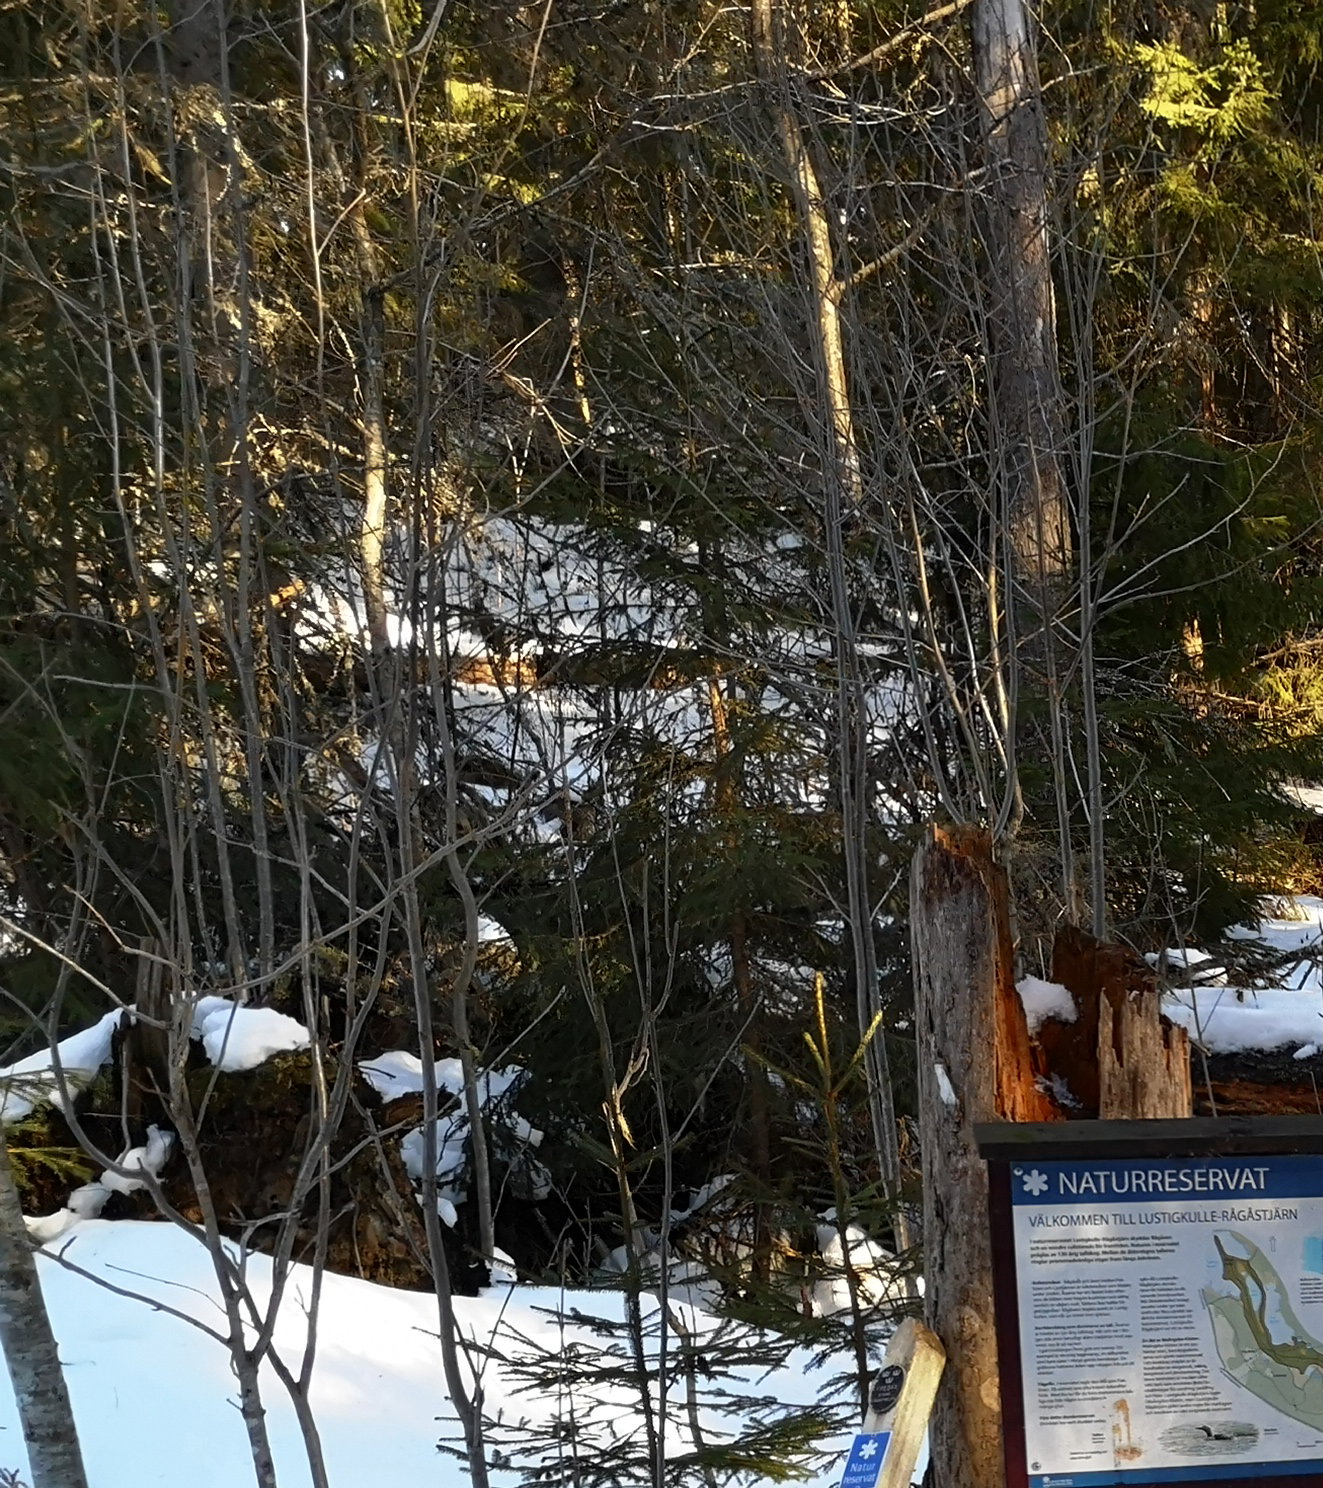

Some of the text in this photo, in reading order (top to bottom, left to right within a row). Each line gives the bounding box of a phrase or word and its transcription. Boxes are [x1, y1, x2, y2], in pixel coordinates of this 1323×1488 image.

[1058, 1168, 1269, 1194] NATURRESERVAT
[1028, 1208, 1298, 1228] VÄLKOMMEN TILL LUSTIGKULLE-RÅGÅSTJÄRN
[850, 1463, 876, 1472] Natur
[842, 1474, 876, 1484] reservat
